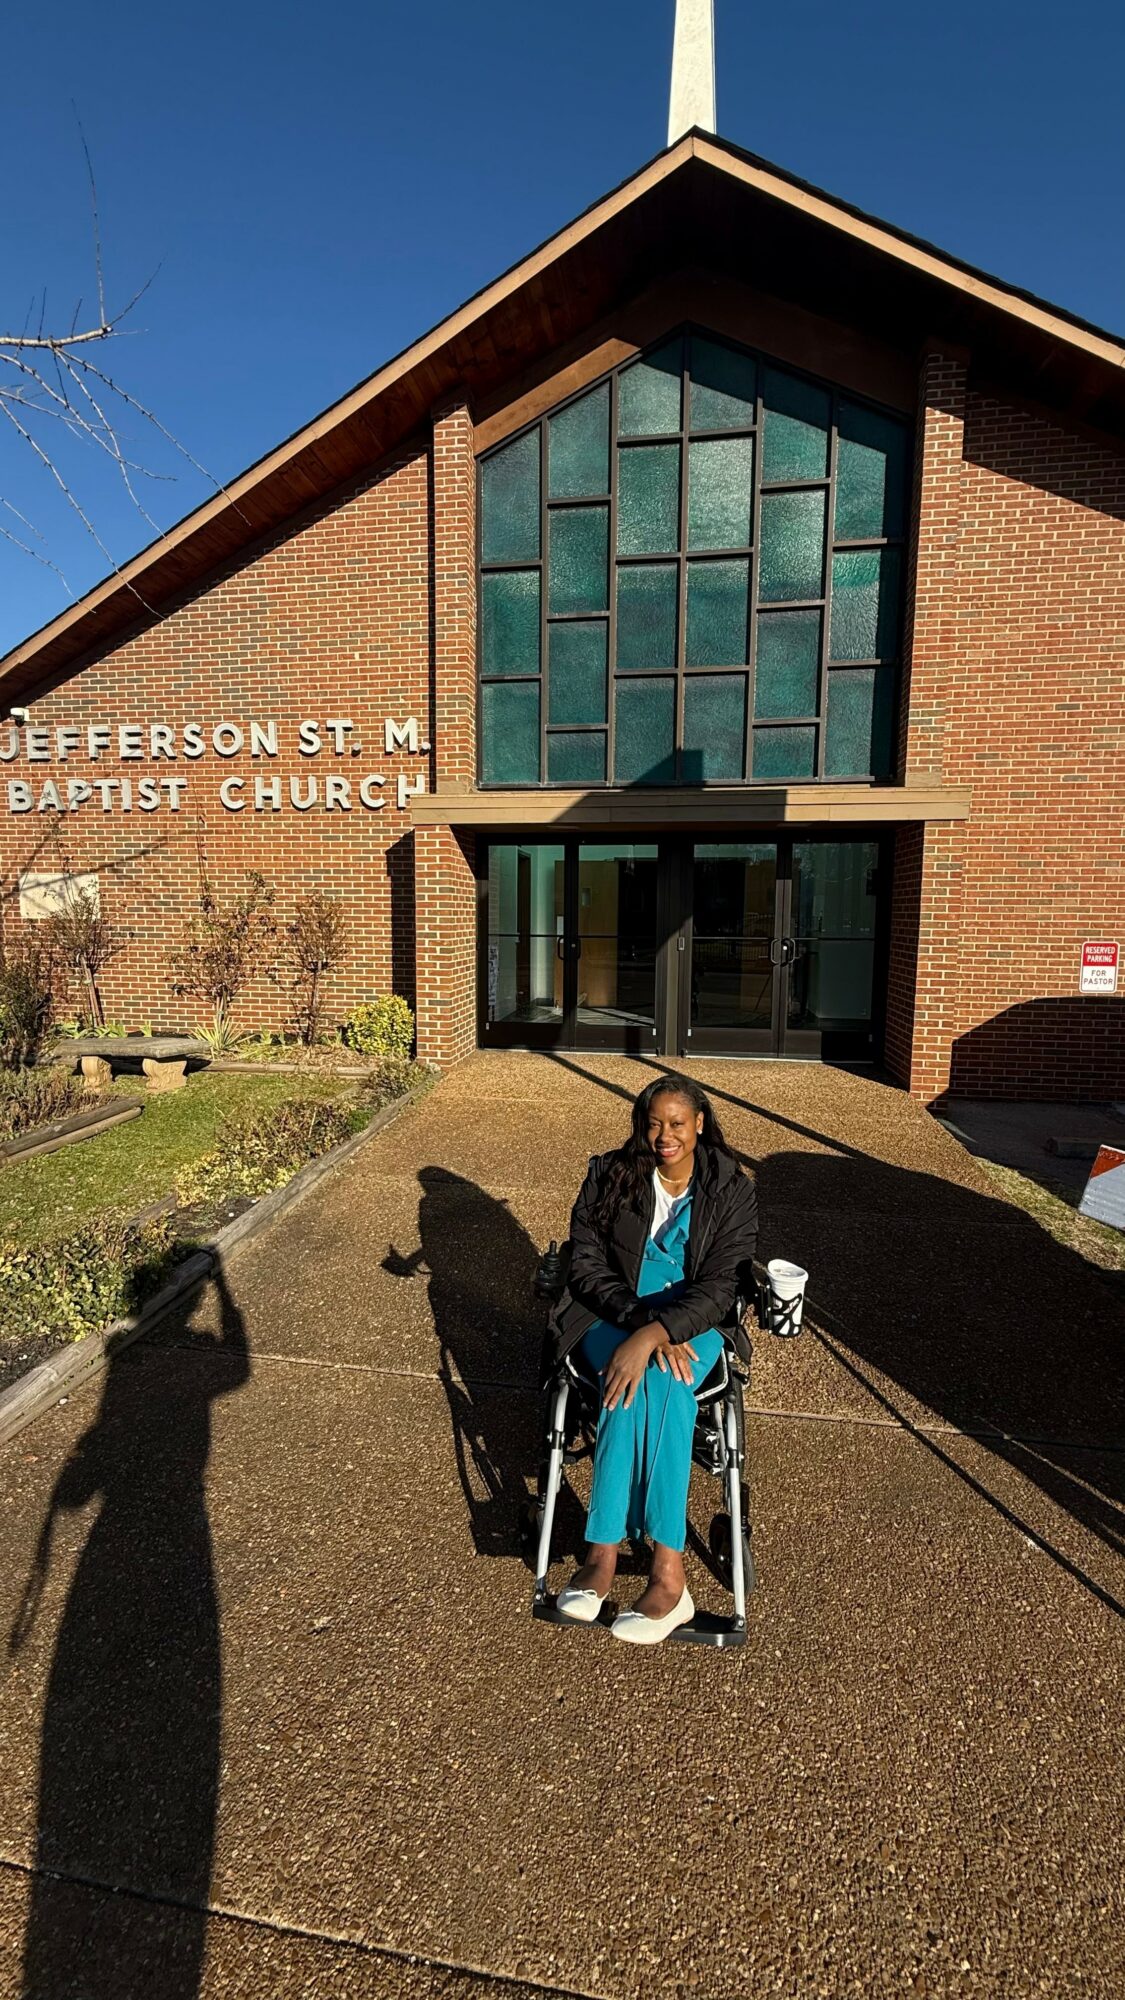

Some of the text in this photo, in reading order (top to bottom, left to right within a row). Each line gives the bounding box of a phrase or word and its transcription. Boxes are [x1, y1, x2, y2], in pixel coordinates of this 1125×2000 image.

[0, 717, 431, 762] JEFFERSON ST. M.
[8, 774, 426, 813] BAPTIST CHURCH
[1085, 946, 1115, 954] RESERVED
